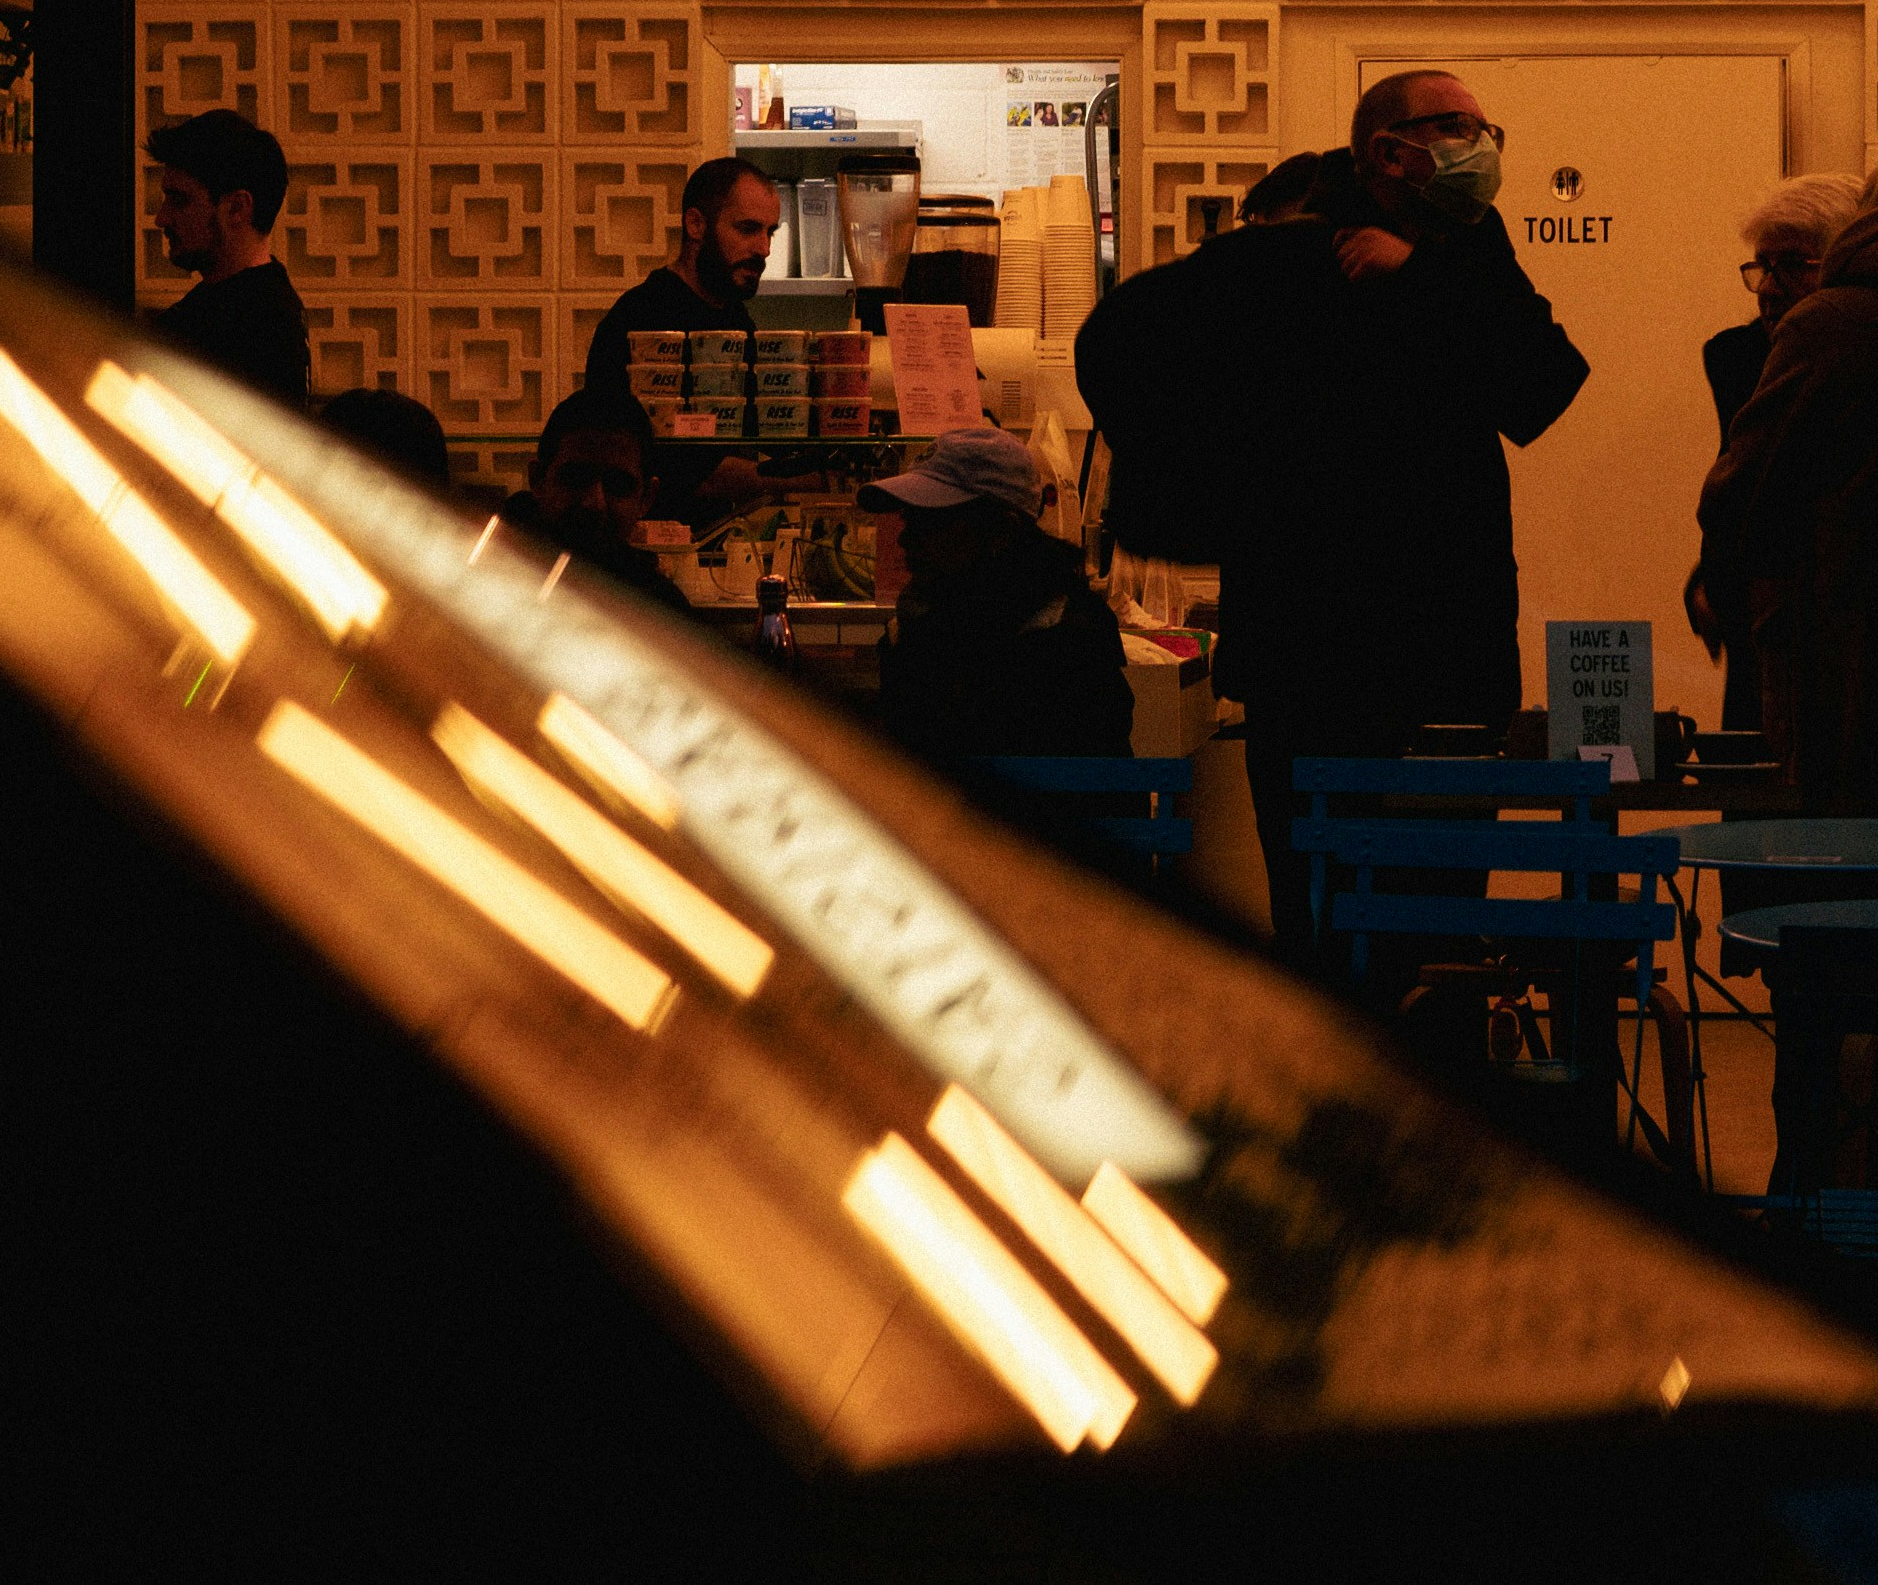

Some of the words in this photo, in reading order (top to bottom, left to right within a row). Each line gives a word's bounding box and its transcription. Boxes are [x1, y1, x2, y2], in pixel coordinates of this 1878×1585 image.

[1523, 216, 1614, 244] TOILET
[764, 373, 792, 386] RISE
[767, 406, 796, 419] RISE
[831, 406, 860, 420] RISE
[1569, 629, 1611, 649] HAVE
[1618, 629, 1630, 649] A
[1569, 654, 1631, 674] COFFEE
[1572, 679, 1595, 699] ON
[1601, 679, 1629, 699] US!
